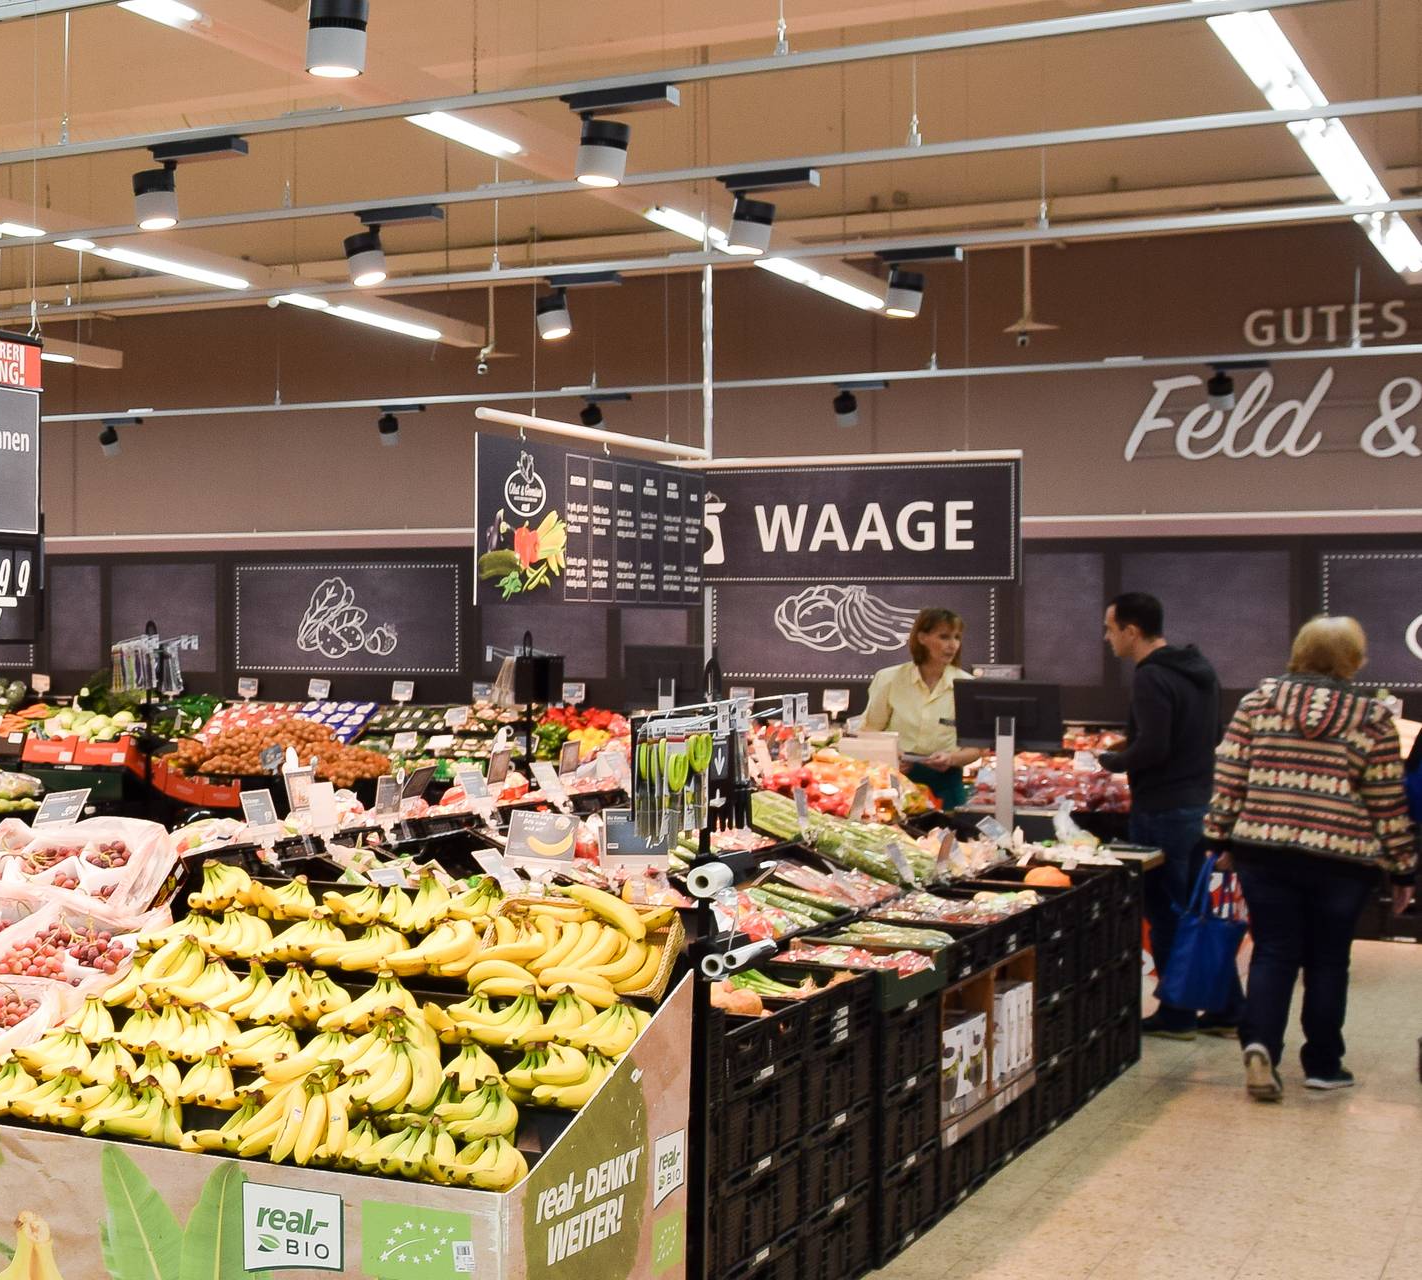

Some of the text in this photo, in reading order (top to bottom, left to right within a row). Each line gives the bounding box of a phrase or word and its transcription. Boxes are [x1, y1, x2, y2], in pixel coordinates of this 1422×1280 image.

[1244, 300, 1407, 346] GUTES
[1124, 367, 1422, 462] Feld &
[754, 500, 974, 552] WAAGE
[536, 1146, 642, 1225] real,- DENKT
[666, 1168, 681, 1185] BIO
[256, 1207, 329, 1236] real,-
[547, 1194, 625, 1266] WEITER!
[286, 1239, 329, 1260] BIO
